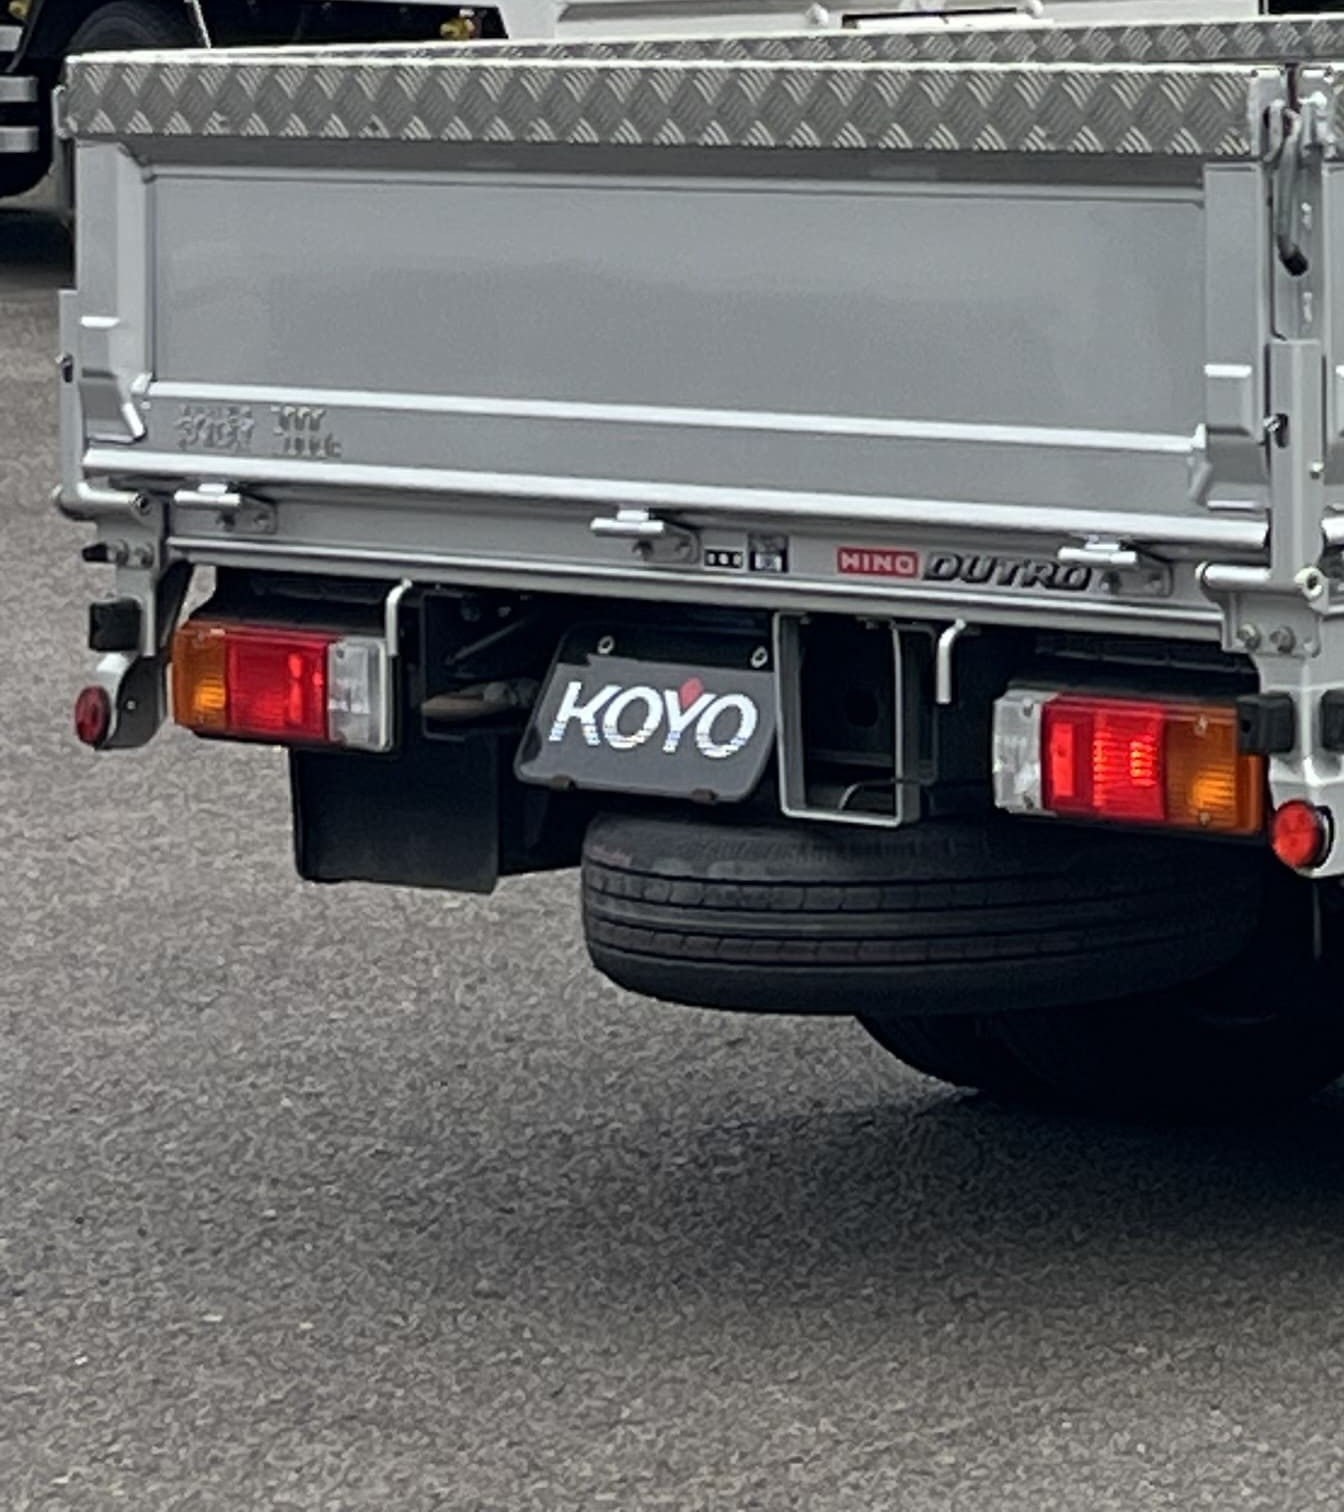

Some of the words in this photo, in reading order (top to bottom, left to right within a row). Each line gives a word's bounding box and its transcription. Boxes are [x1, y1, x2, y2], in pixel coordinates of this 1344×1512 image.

[839, 554, 917, 576] HINO
[922, 552, 1094, 591] DUTRO
[547, 678, 758, 759] KOYO
